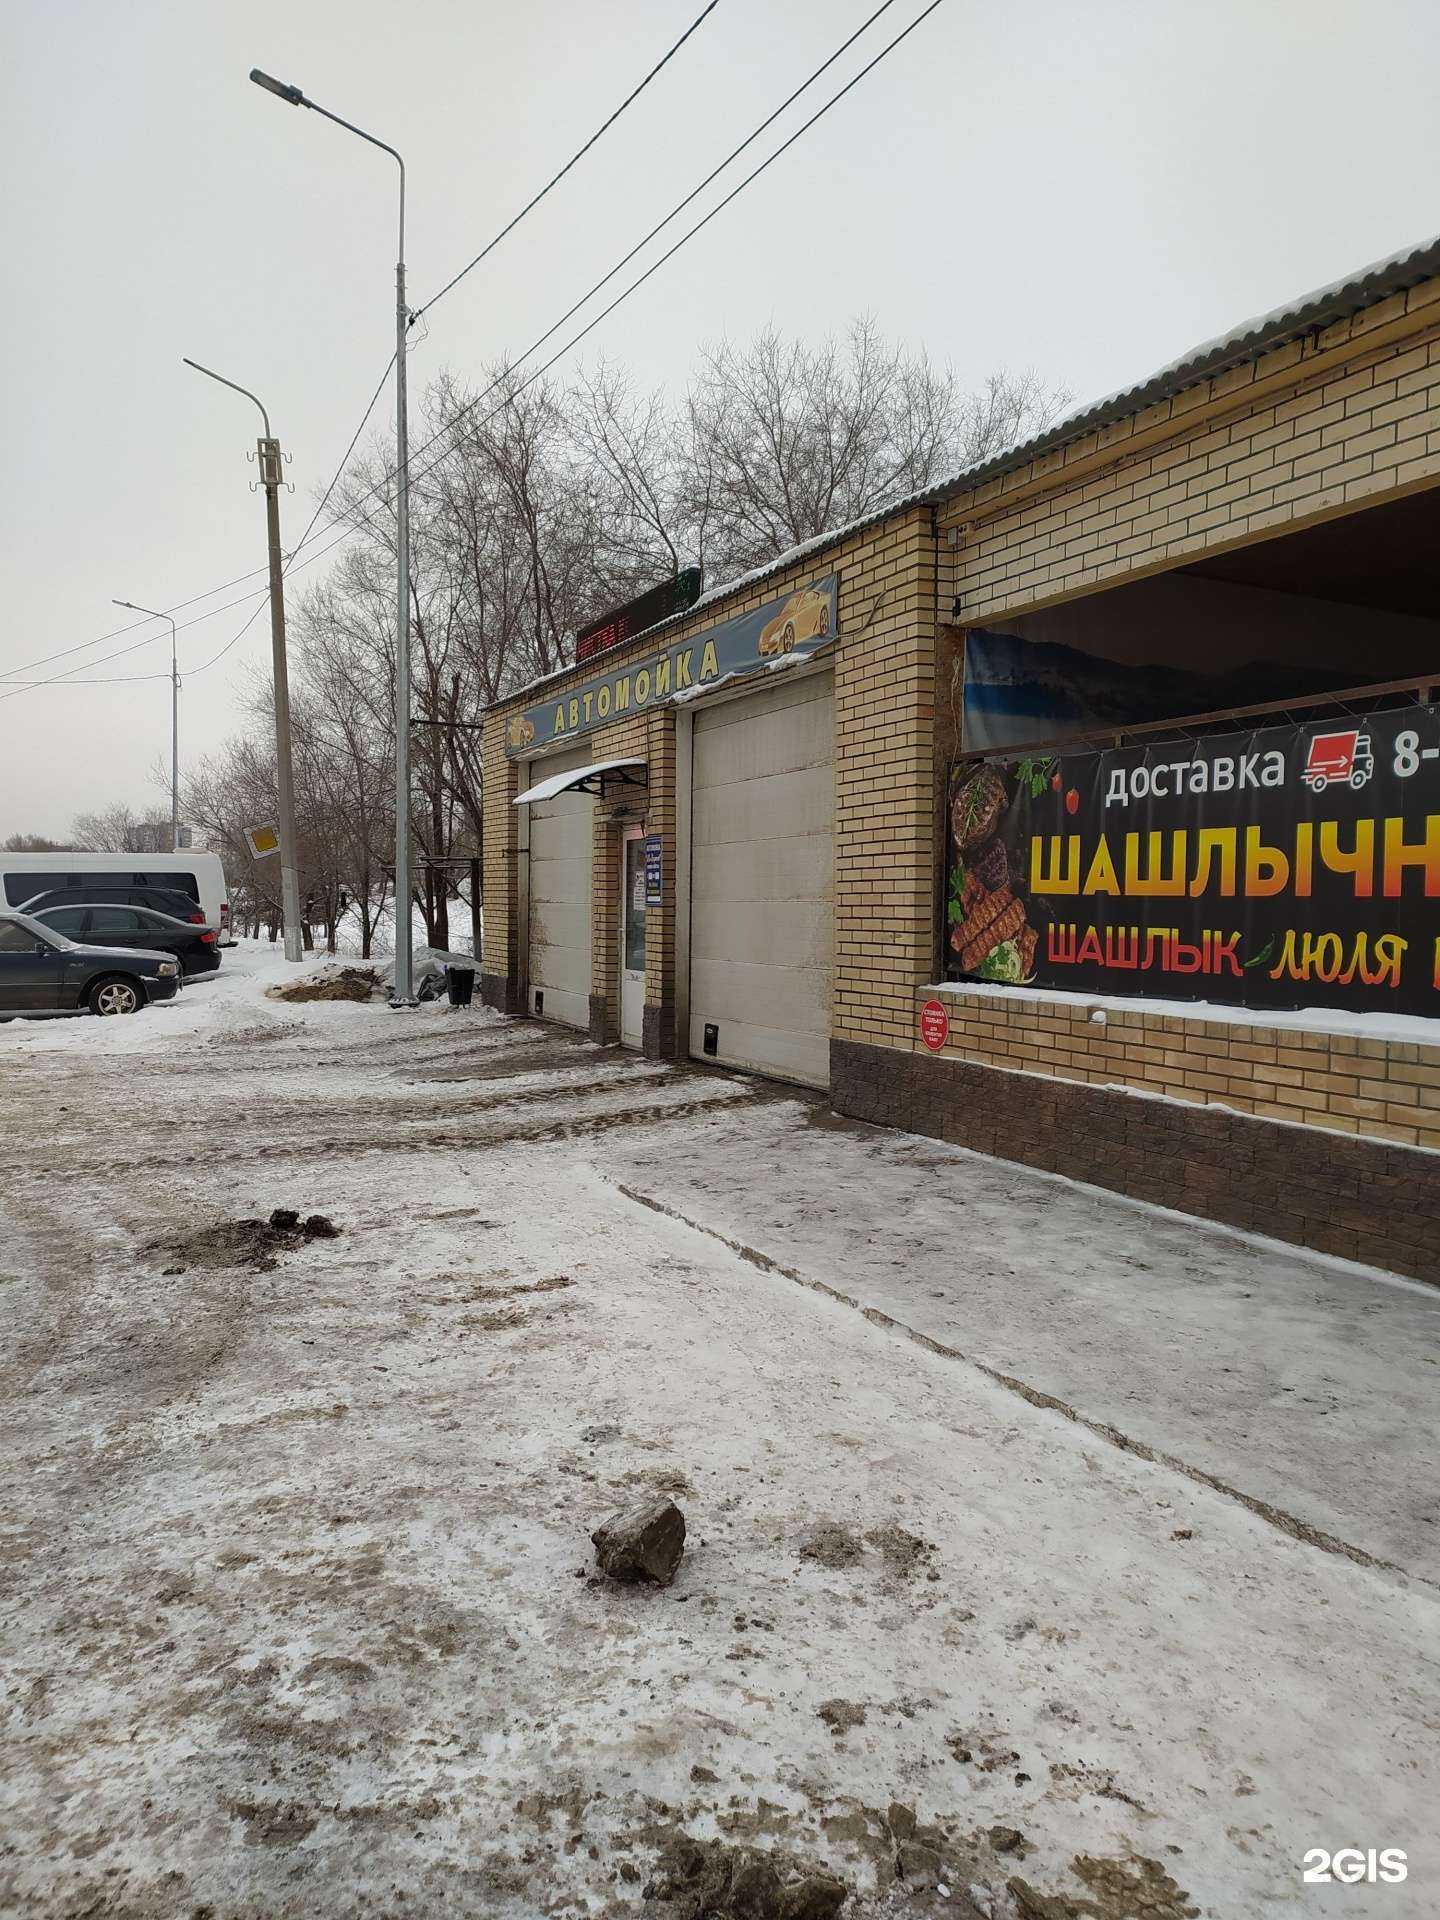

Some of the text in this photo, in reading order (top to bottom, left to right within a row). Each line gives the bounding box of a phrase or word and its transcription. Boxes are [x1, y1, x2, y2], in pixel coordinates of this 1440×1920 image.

[553, 640, 719, 735] АВТОМОЙКА
[1105, 751, 1285, 808] доставка
[1031, 815, 1440, 898] ШАШЛЫЧН
[1048, 923, 1244, 977] ШАШЛЫК
[1269, 929, 1409, 988] ЛЮЛЯ
